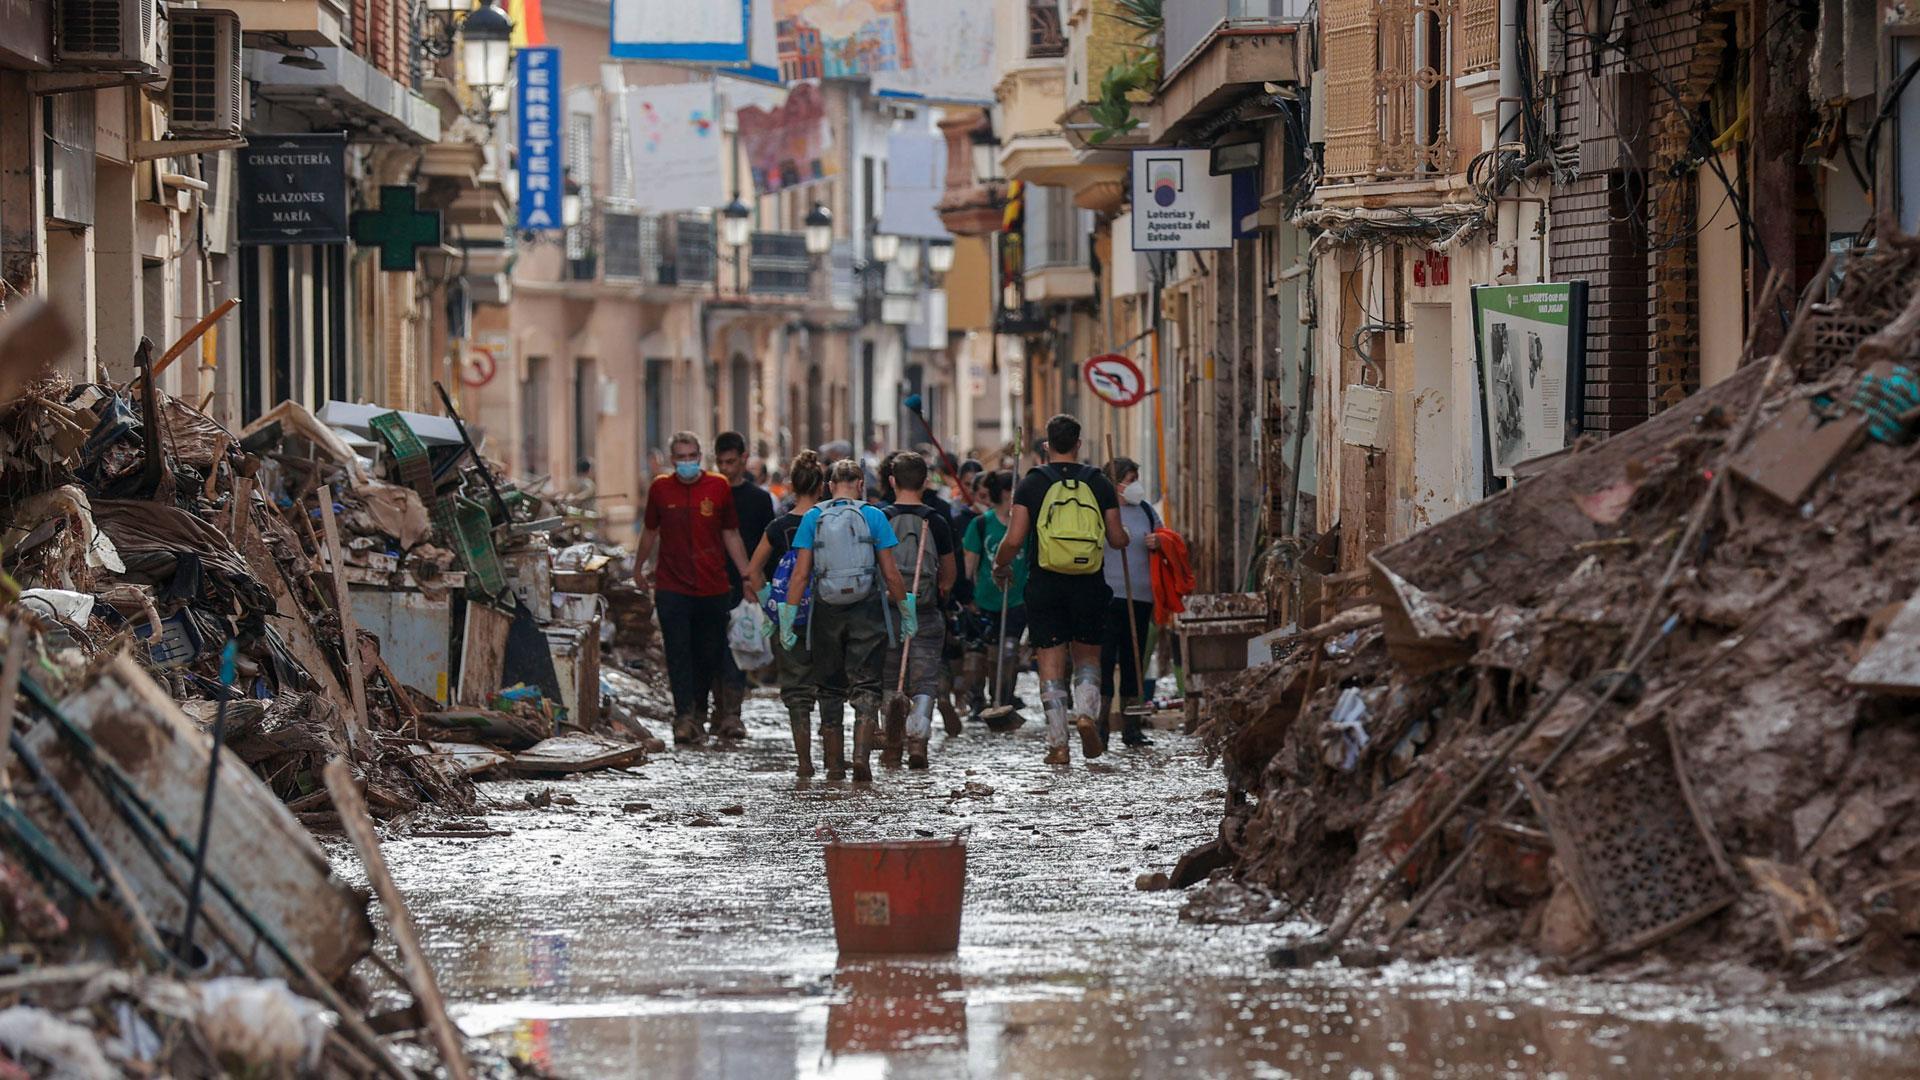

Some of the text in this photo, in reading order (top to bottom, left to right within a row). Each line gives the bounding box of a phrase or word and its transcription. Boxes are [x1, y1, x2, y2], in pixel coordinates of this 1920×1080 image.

[249, 152, 331, 164] CHARCUTERÍA
[286, 173, 295, 184] Y
[257, 192, 325, 203] SALAZONES
[272, 210, 312, 222] MARÍA
[1189, 211, 1195, 219] y
[1148, 220, 1210, 231] Apuestas del
[1147, 232, 1181, 241] Estado
